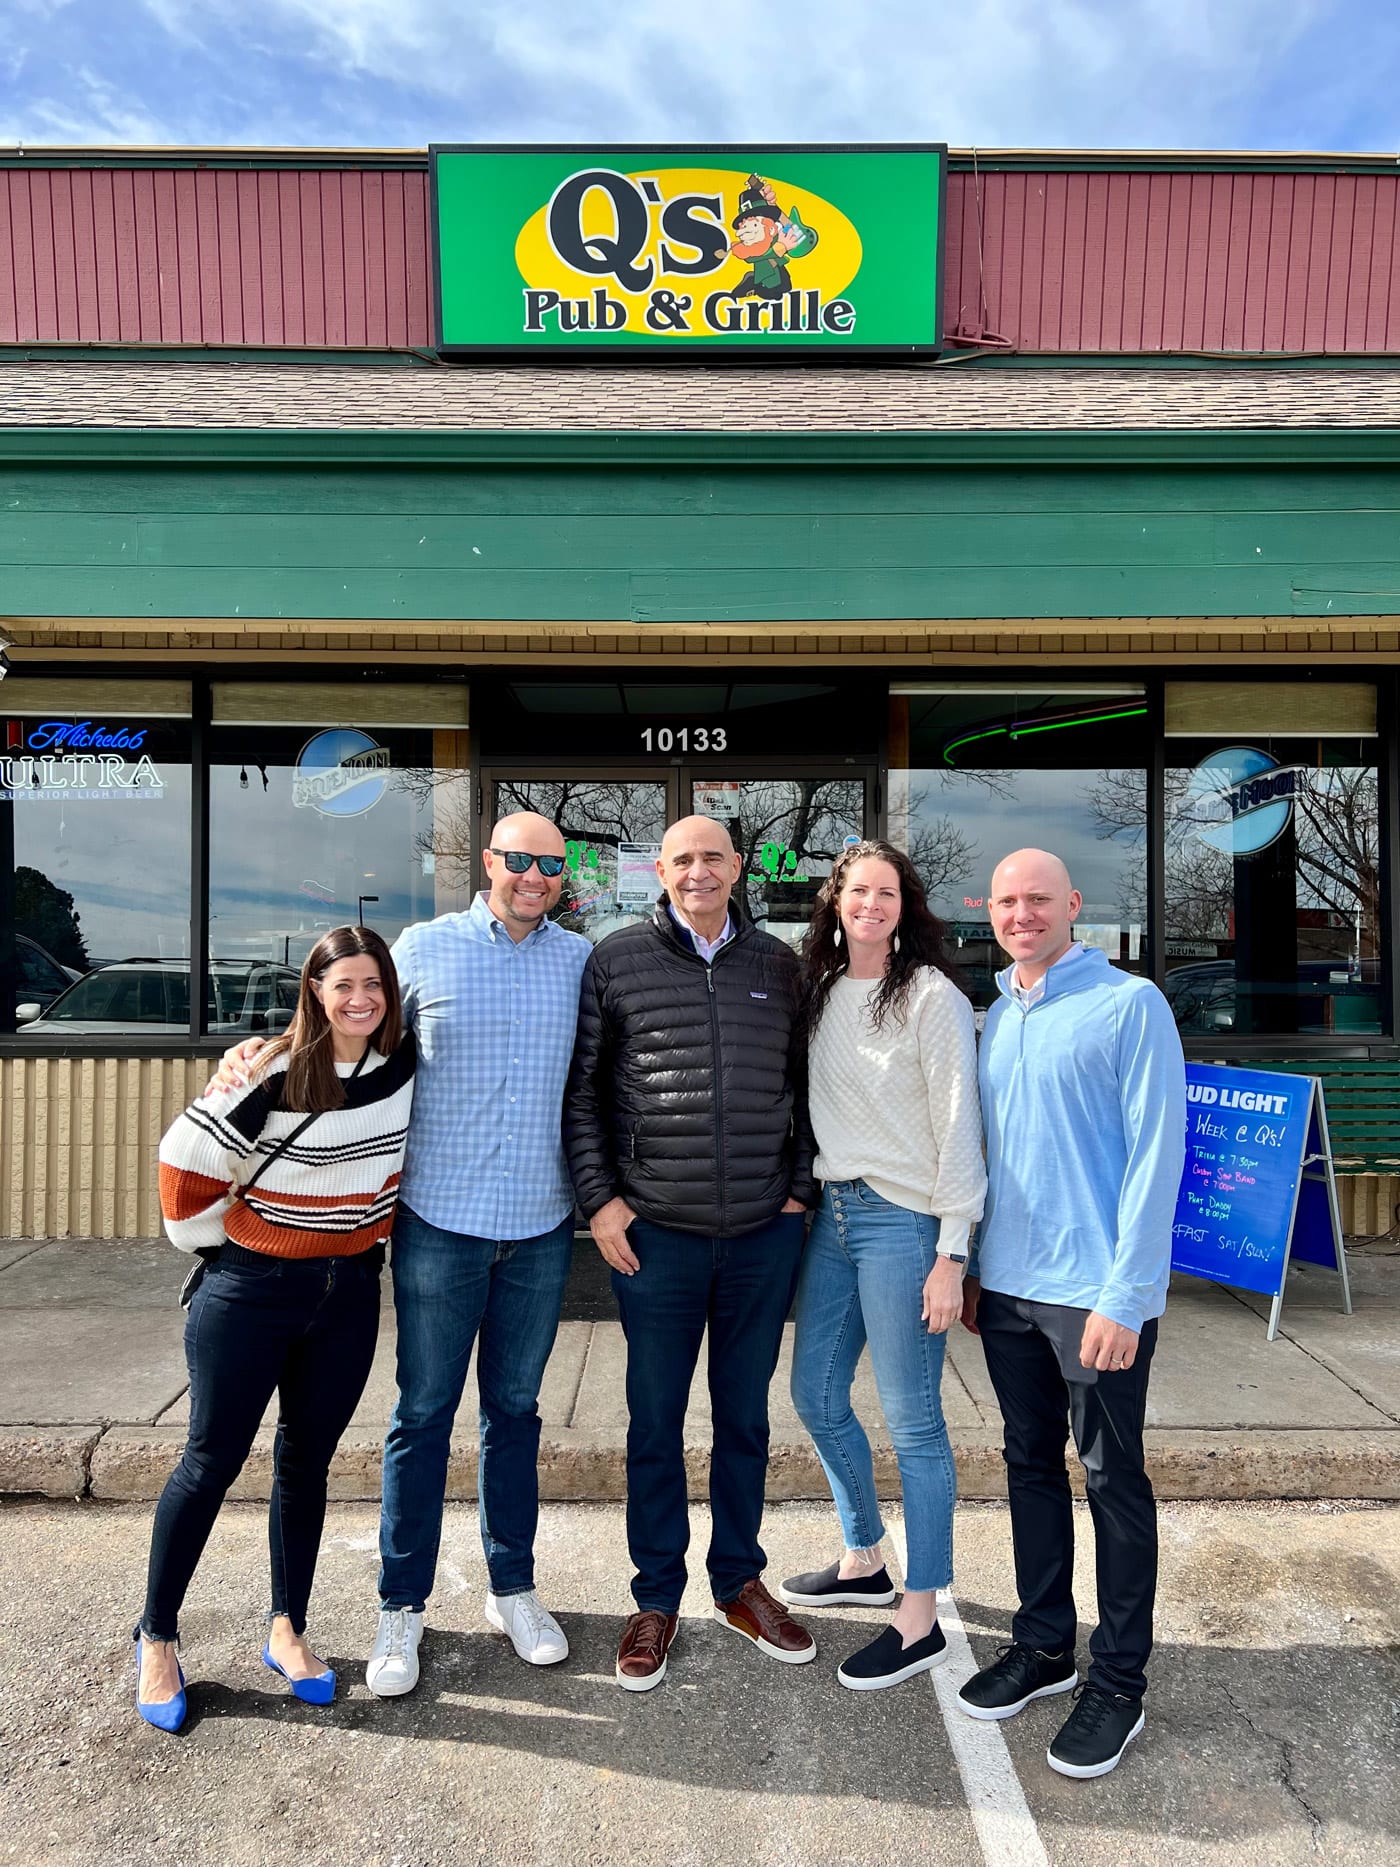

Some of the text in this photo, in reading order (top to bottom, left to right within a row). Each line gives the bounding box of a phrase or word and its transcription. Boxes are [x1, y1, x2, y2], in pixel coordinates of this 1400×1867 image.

[548, 168, 730, 294] Q's
[523, 288, 856, 336] Pub & Grille
[28, 721, 148, 749] Michelob
[641, 727, 727, 752] 10133
[0, 753, 164, 790] ULTRA
[0, 790, 164, 800] SUPERIOR LIGHT BEER
[565, 840, 600, 872] Q's
[761, 841, 798, 874] Q's
[1186, 1084, 1218, 1105] UD
[1195, 1113, 1228, 1141] WEEK
